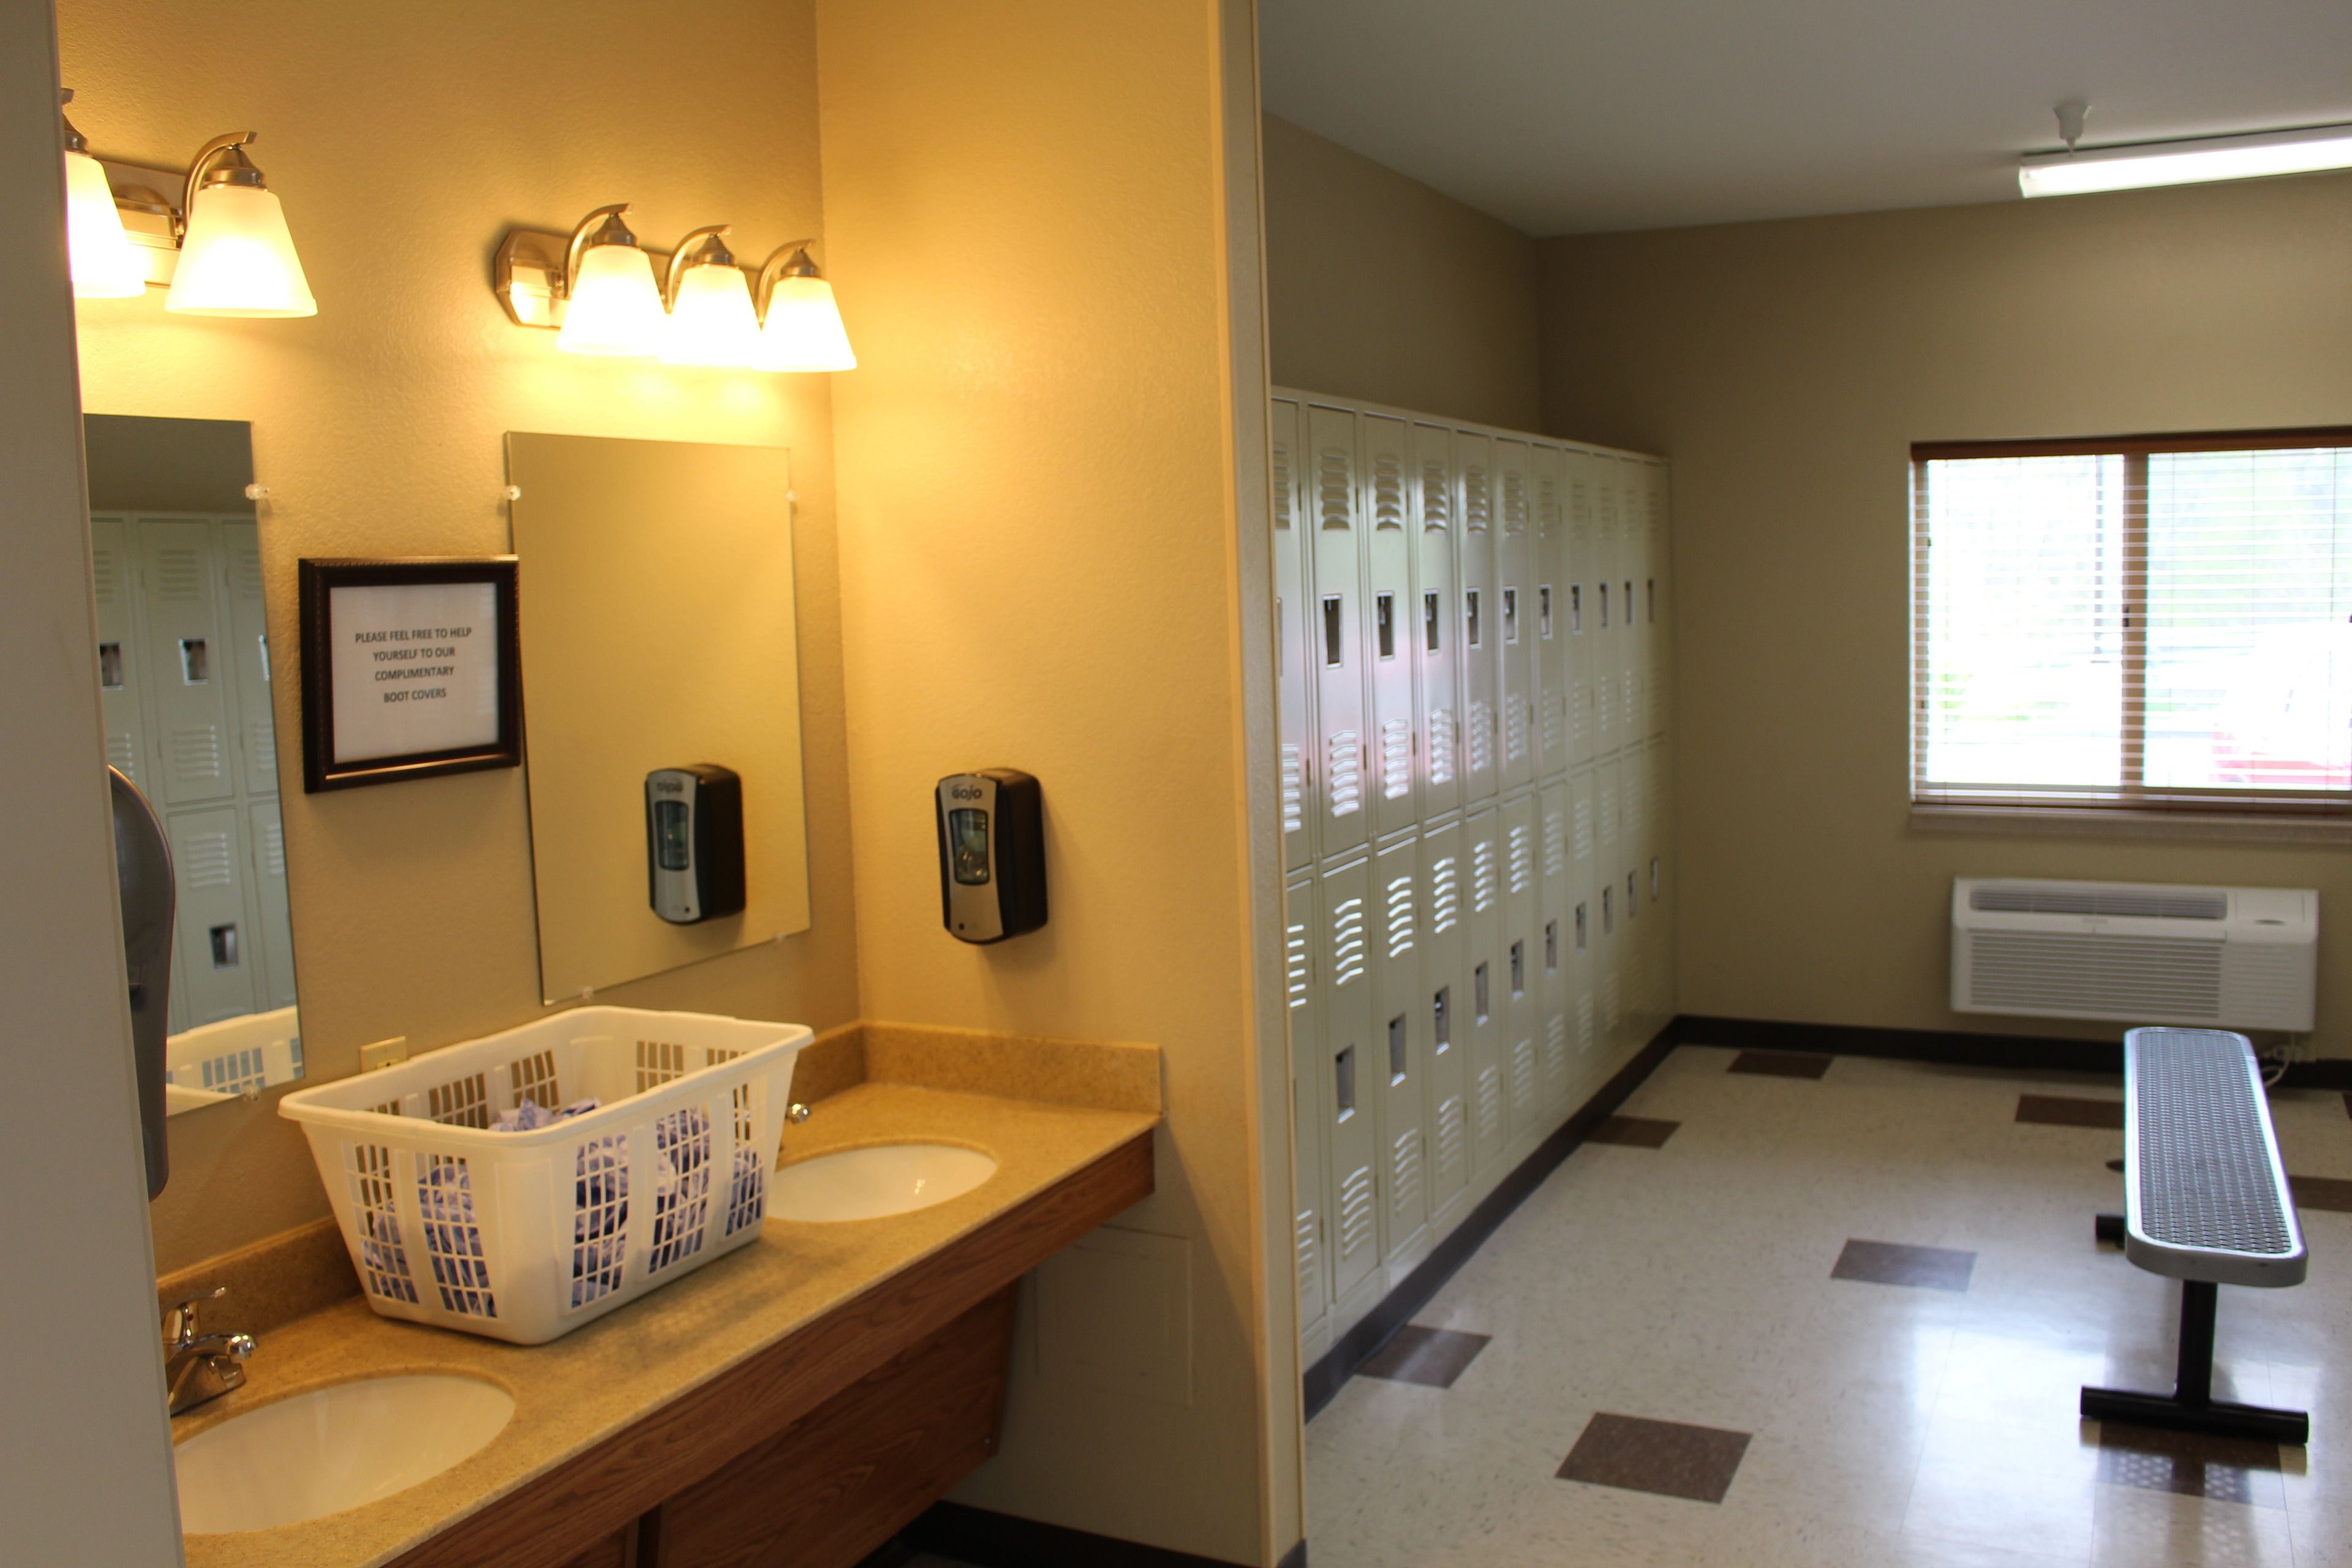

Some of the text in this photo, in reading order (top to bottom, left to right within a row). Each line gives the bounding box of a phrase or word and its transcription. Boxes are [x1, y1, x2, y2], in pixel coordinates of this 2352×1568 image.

[355, 627, 472, 643] PLEASE FEEL FREE TO HELP
[372, 646, 455, 662] YOURSELF TO OUR
[375, 666, 455, 681] COMPLIMENTARY
[383, 687, 447, 703] BOOT COVERS
